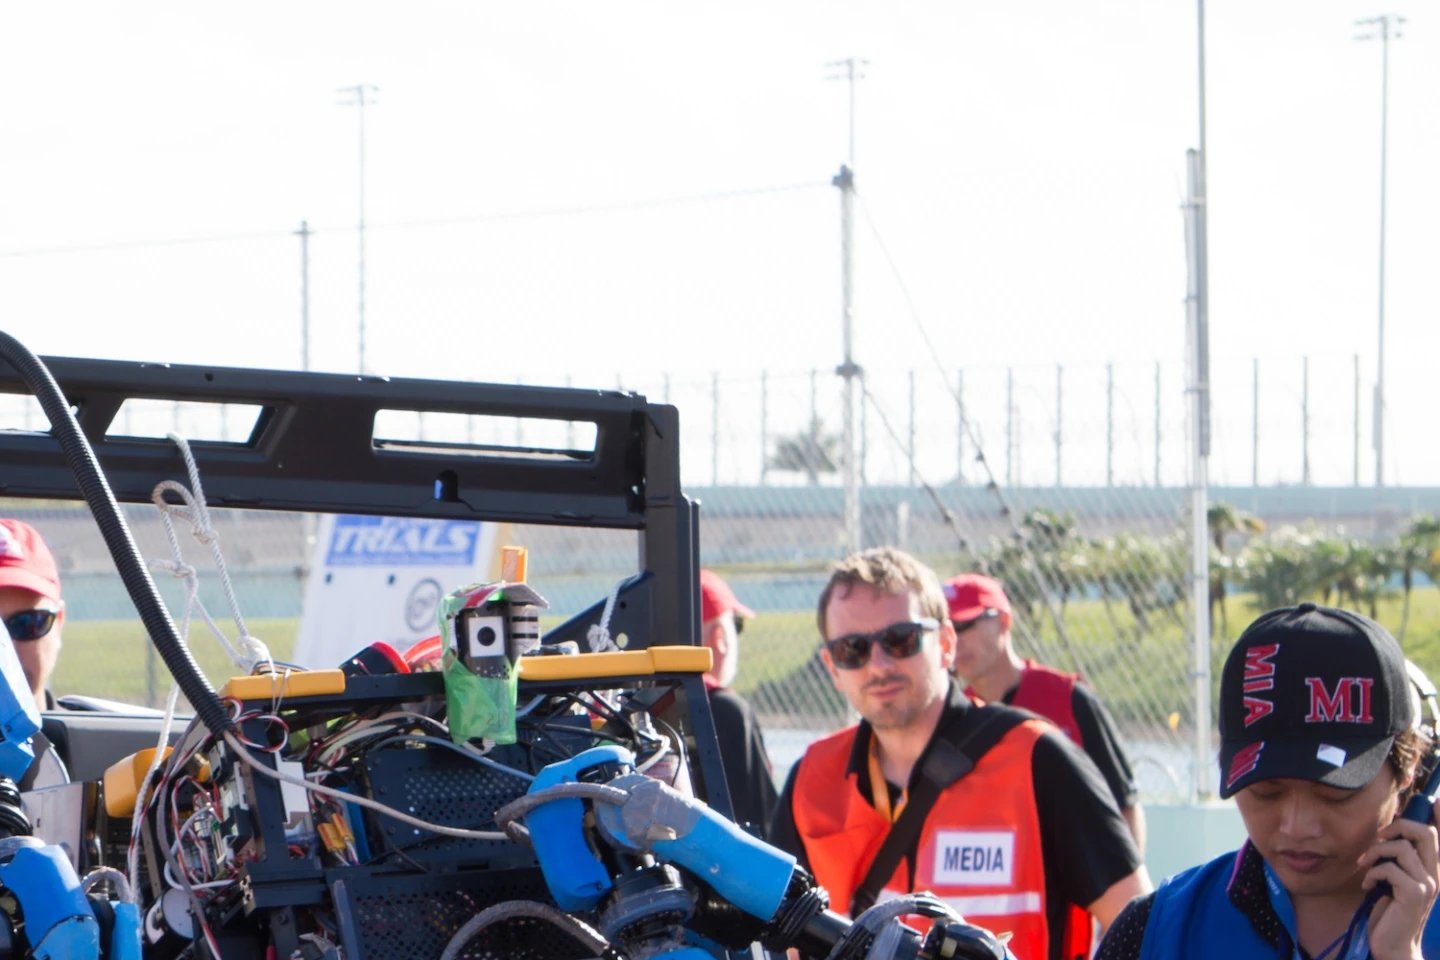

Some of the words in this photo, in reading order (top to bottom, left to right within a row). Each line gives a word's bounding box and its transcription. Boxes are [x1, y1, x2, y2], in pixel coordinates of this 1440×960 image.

[334, 525, 477, 554] TRIALS
[1304, 676, 1375, 724] MI
[942, 846, 1005, 872] MEDIA
